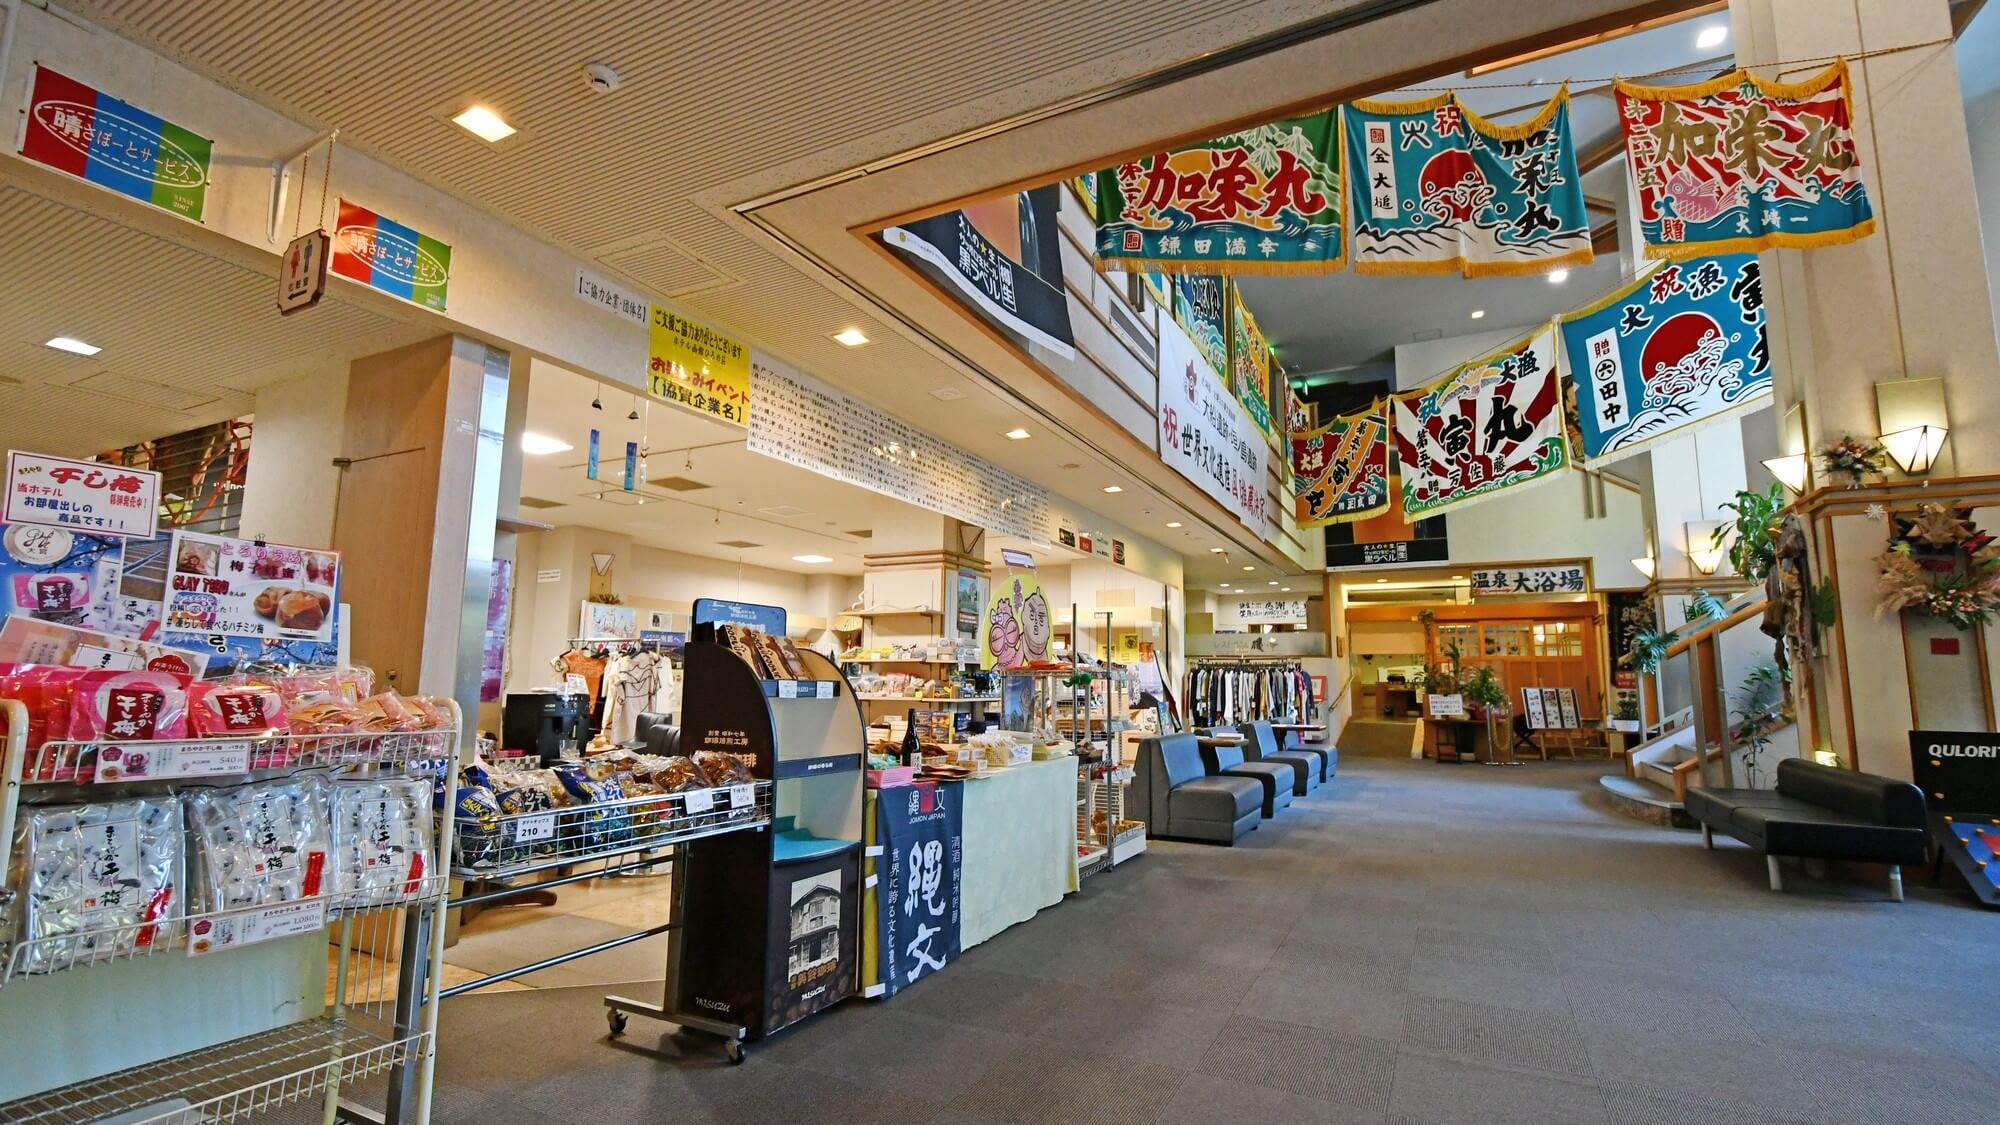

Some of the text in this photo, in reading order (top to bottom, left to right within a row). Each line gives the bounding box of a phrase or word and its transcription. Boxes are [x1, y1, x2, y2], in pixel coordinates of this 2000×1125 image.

[1645, 98, 1858, 181] 加栄丸
[1135, 146, 1330, 222] 加栄丸
[1163, 402, 1178, 449] 祝
[17, 483, 62, 497] 当ホテル
[49, 467, 144, 494] 干し梅
[24, 496, 92, 513] お部屋出しの
[1473, 568, 1584, 593] 温泉大浴場
[909, 813, 945, 824] JOMON JAPAN
[521, 827, 538, 837] 210
[904, 840, 946, 984] 縄文
